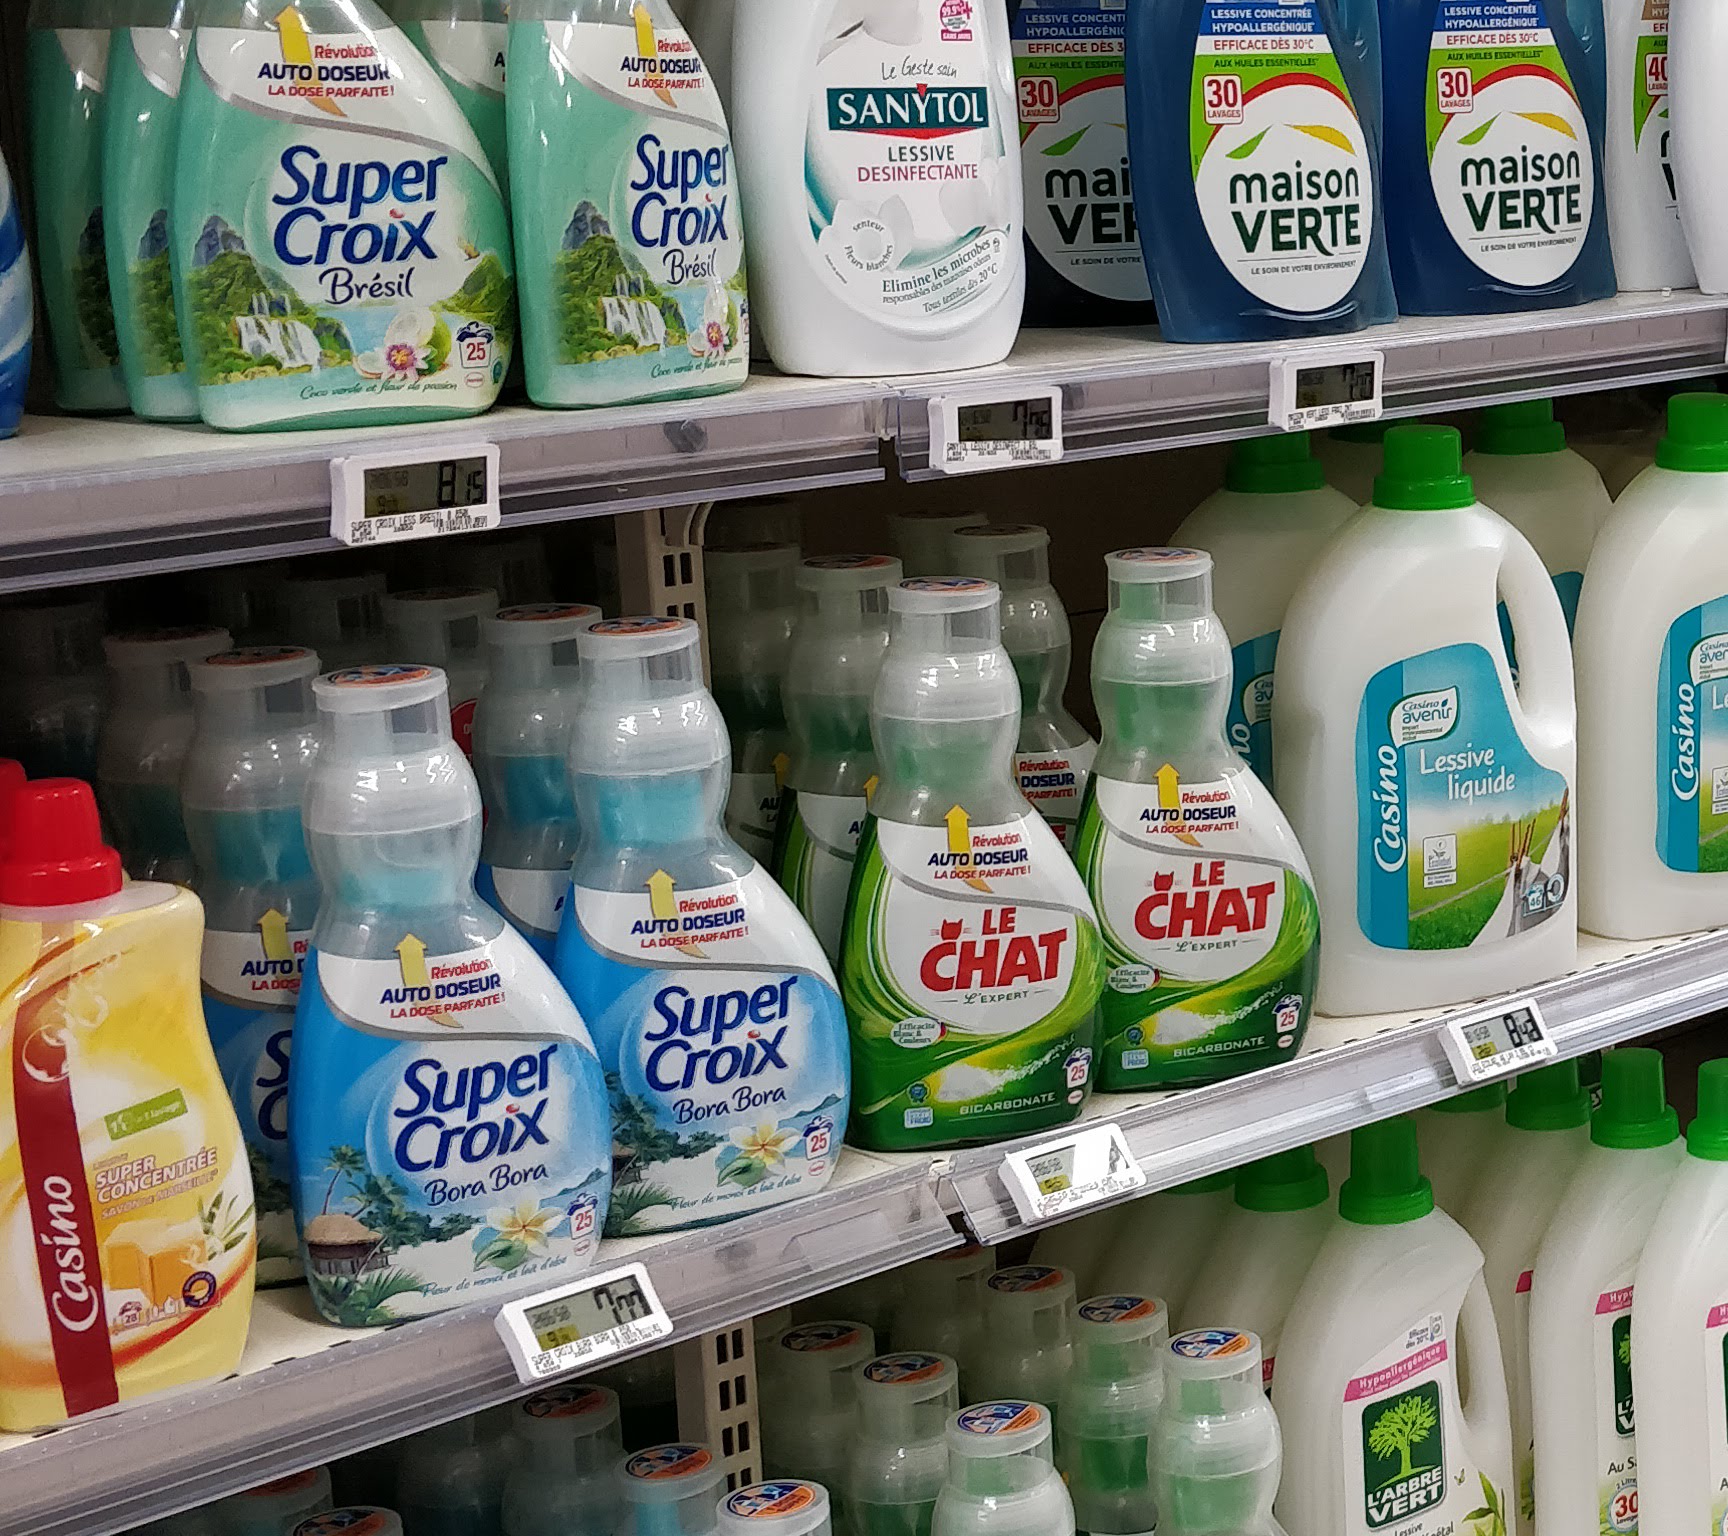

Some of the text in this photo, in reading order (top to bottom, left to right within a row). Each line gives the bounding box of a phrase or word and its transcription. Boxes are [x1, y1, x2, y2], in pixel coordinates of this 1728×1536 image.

[1211, 7, 1312, 19] LESSIVE CONCENTRÉE
[1444, 4, 1536, 16] LESSIVE CONCENTRÉE
[1214, 36, 1314, 51] EFFICACE DÈS 30°C
[1446, 31, 1539, 45] EFFICACE DÈS 30°C
[1208, 79, 1237, 107] 30
[1441, 71, 1469, 98] 30
[838, 91, 984, 127] SANYTOL
[1208, 109, 1240, 119] LAVAGES
[1441, 99, 1471, 108] LAVAGES
[888, 144, 954, 162] LESSIVE
[1460, 146, 1580, 187] maison
[272, 145, 448, 207] Super
[857, 164, 978, 183] DESINFECTANTE
[1229, 161, 1359, 203] maison
[1463, 185, 1581, 234] VERTE
[274, 207, 438, 265] Croix
[1232, 205, 1361, 256] VERTE
[662, 247, 717, 285] Brésil
[319, 265, 414, 305] Brésil
[1671, 682, 1697, 801] Casino
[1420, 744, 1495, 775] Lessive
[1448, 772, 1515, 805] liquide
[1140, 806, 1236, 822] AUTO DOSEUR
[1374, 744, 1408, 872] Casino
[928, 848, 1028, 866] AUTO DOSEUR
[1192, 860, 1226, 887] LE
[679, 894, 739, 912] Révolution
[982, 906, 1015, 933] LE
[1134, 881, 1276, 942] CHAT
[631, 909, 745, 934] AUTO DOSEUR
[431, 959, 493, 979] Révolution
[920, 929, 1068, 992] CHAT
[380, 973, 501, 1003] AUTO DOSEUR
[645, 976, 798, 1042] Super
[646, 1025, 788, 1093] Croix
[1173, 1035, 1265, 1058] BICARBONATE
[393, 1044, 557, 1124] Super
[673, 1087, 787, 1124] Bora Bora
[959, 1092, 1056, 1115] BICARBONATE
[393, 1098, 549, 1173] Croix
[811, 1133, 828, 1151] 25
[94, 1153, 156, 1189] SUPER
[96, 1145, 218, 1203] CONCENTRÉE
[425, 1162, 549, 1206] Bora Bora
[575, 1212, 593, 1231] 25
[43, 1175, 98, 1333] Casino
[1358, 1344, 1441, 1392] Hypoallergénique
[1367, 1465, 1442, 1508] L'ARBRE
[1368, 1489, 1443, 1523] VERT
